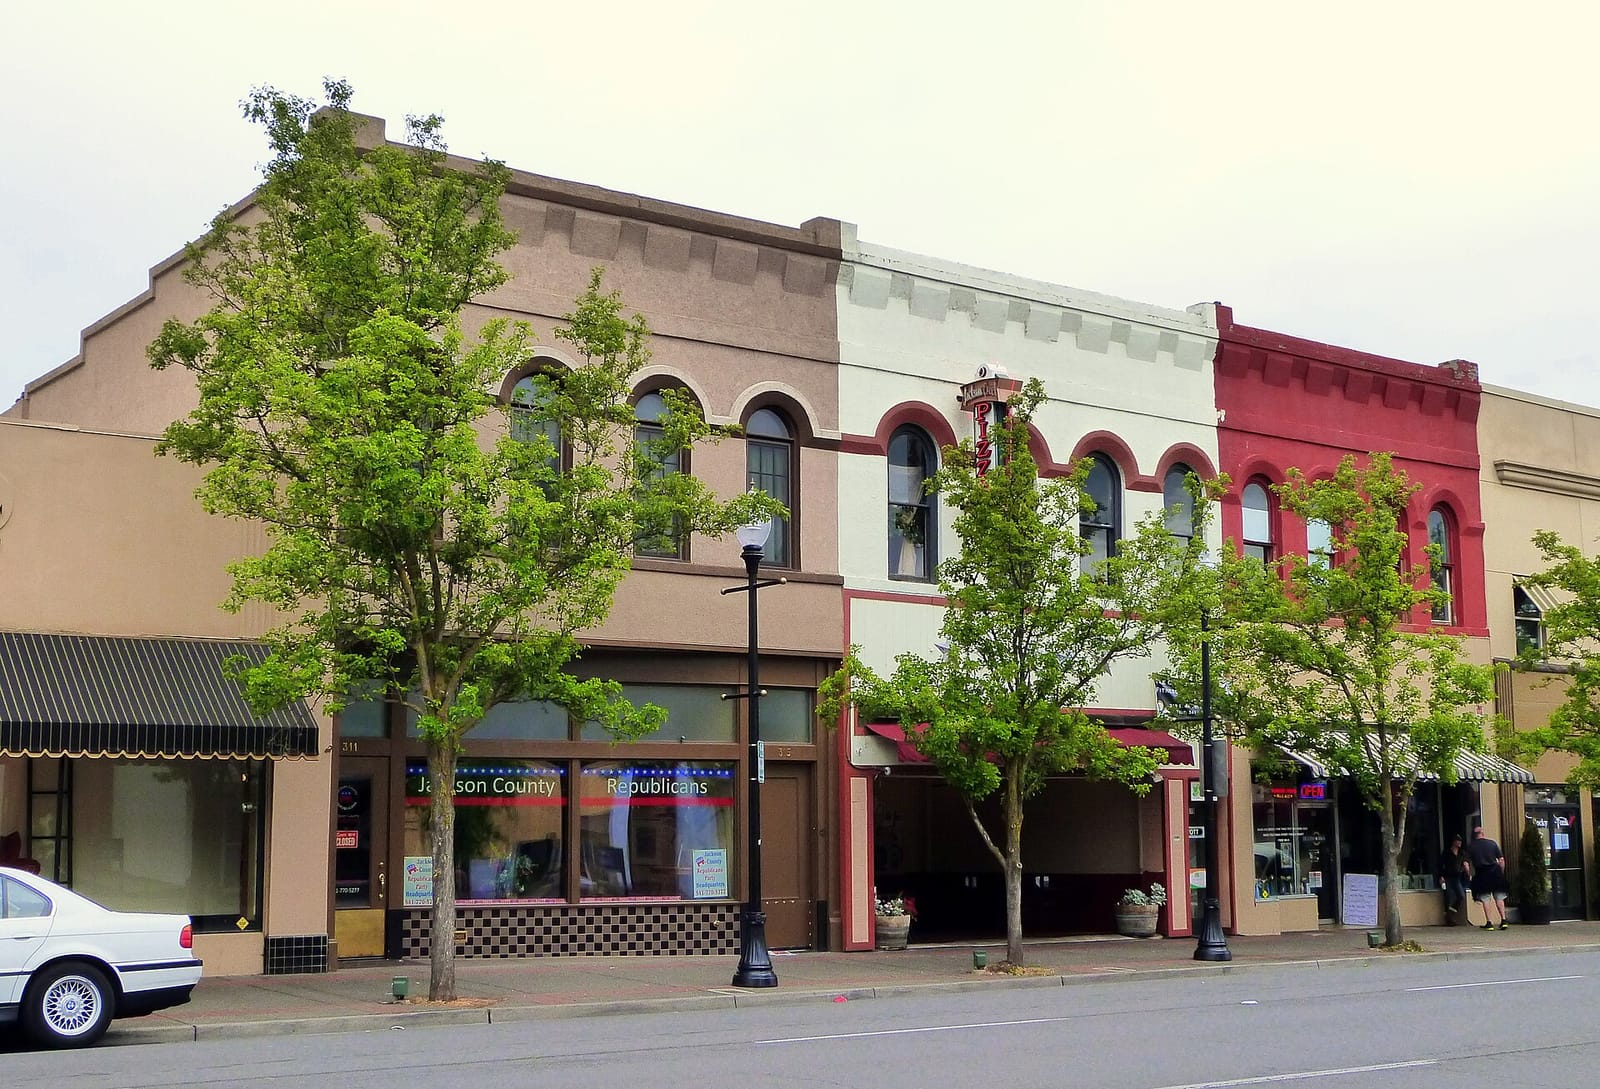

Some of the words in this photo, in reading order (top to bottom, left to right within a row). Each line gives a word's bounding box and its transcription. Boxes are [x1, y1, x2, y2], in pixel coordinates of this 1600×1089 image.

[342, 742, 359, 752] 311
[777, 747, 792, 758] 35
[418, 776, 487, 793] Jason
[493, 777, 556, 797] County
[607, 777, 708, 797] Republicans
[1300, 784, 1325, 798] OPEN
[336, 837, 356, 846] CLOSED
